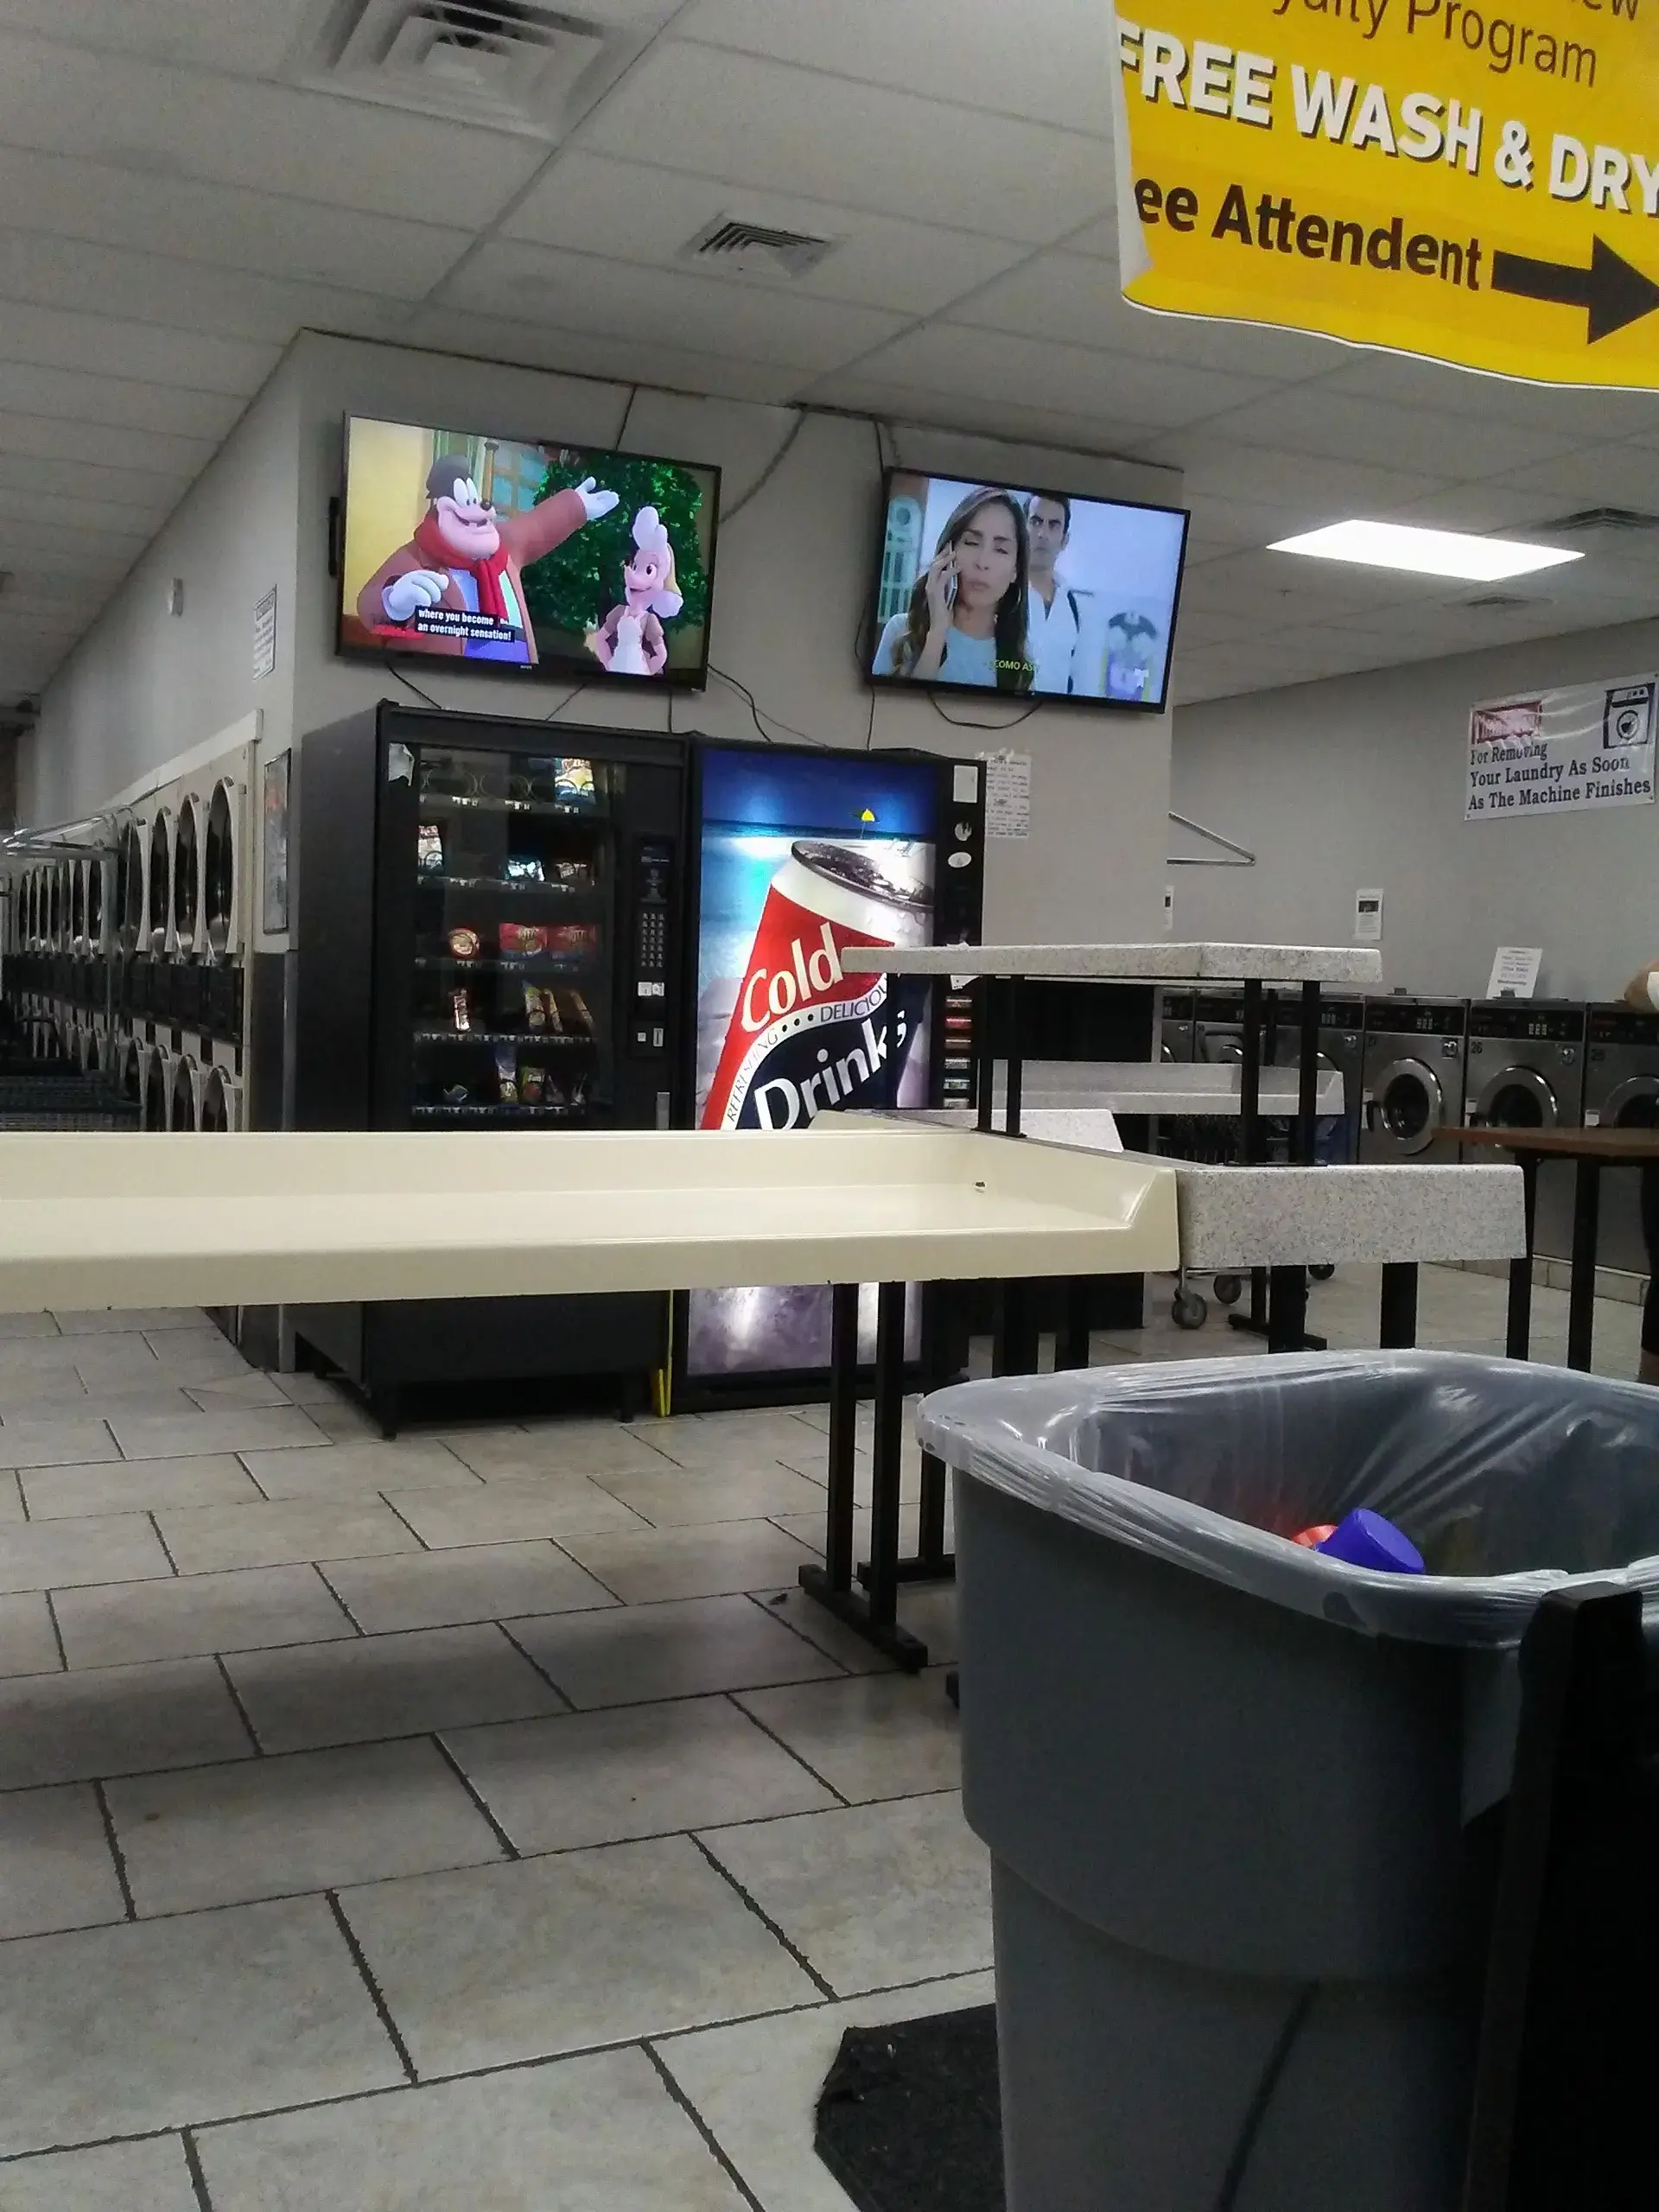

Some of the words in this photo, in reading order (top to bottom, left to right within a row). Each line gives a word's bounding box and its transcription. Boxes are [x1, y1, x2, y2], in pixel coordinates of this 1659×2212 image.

[1408, 0, 1597, 87] Program
[1117, 17, 1278, 130] FREE
[1291, 64, 1484, 177] WASH
[1493, 120, 1535, 191] &
[1548, 131, 1659, 218] DRY
[1134, 177, 1198, 232] ee
[1211, 183, 1482, 291] Attendent
[417, 622, 429, 632] an
[429, 624, 469, 638] overnight
[470, 628, 512, 641] sensation!
[418, 608, 444, 620] where
[445, 612, 461, 623] you
[461, 612, 494, 626] become
[1491, 742, 1548, 761] Removing
[1470, 770, 1502, 787] Your
[1504, 762, 1564, 783] Laundry
[1567, 759, 1587, 776] As
[1592, 756, 1630, 774] Soon
[1468, 794, 1484, 810] As
[1488, 791, 1515, 809] The
[1519, 785, 1581, 806] Machine
[1585, 777, 1651, 799] Finishes
[741, 922, 843, 1033] Cold
